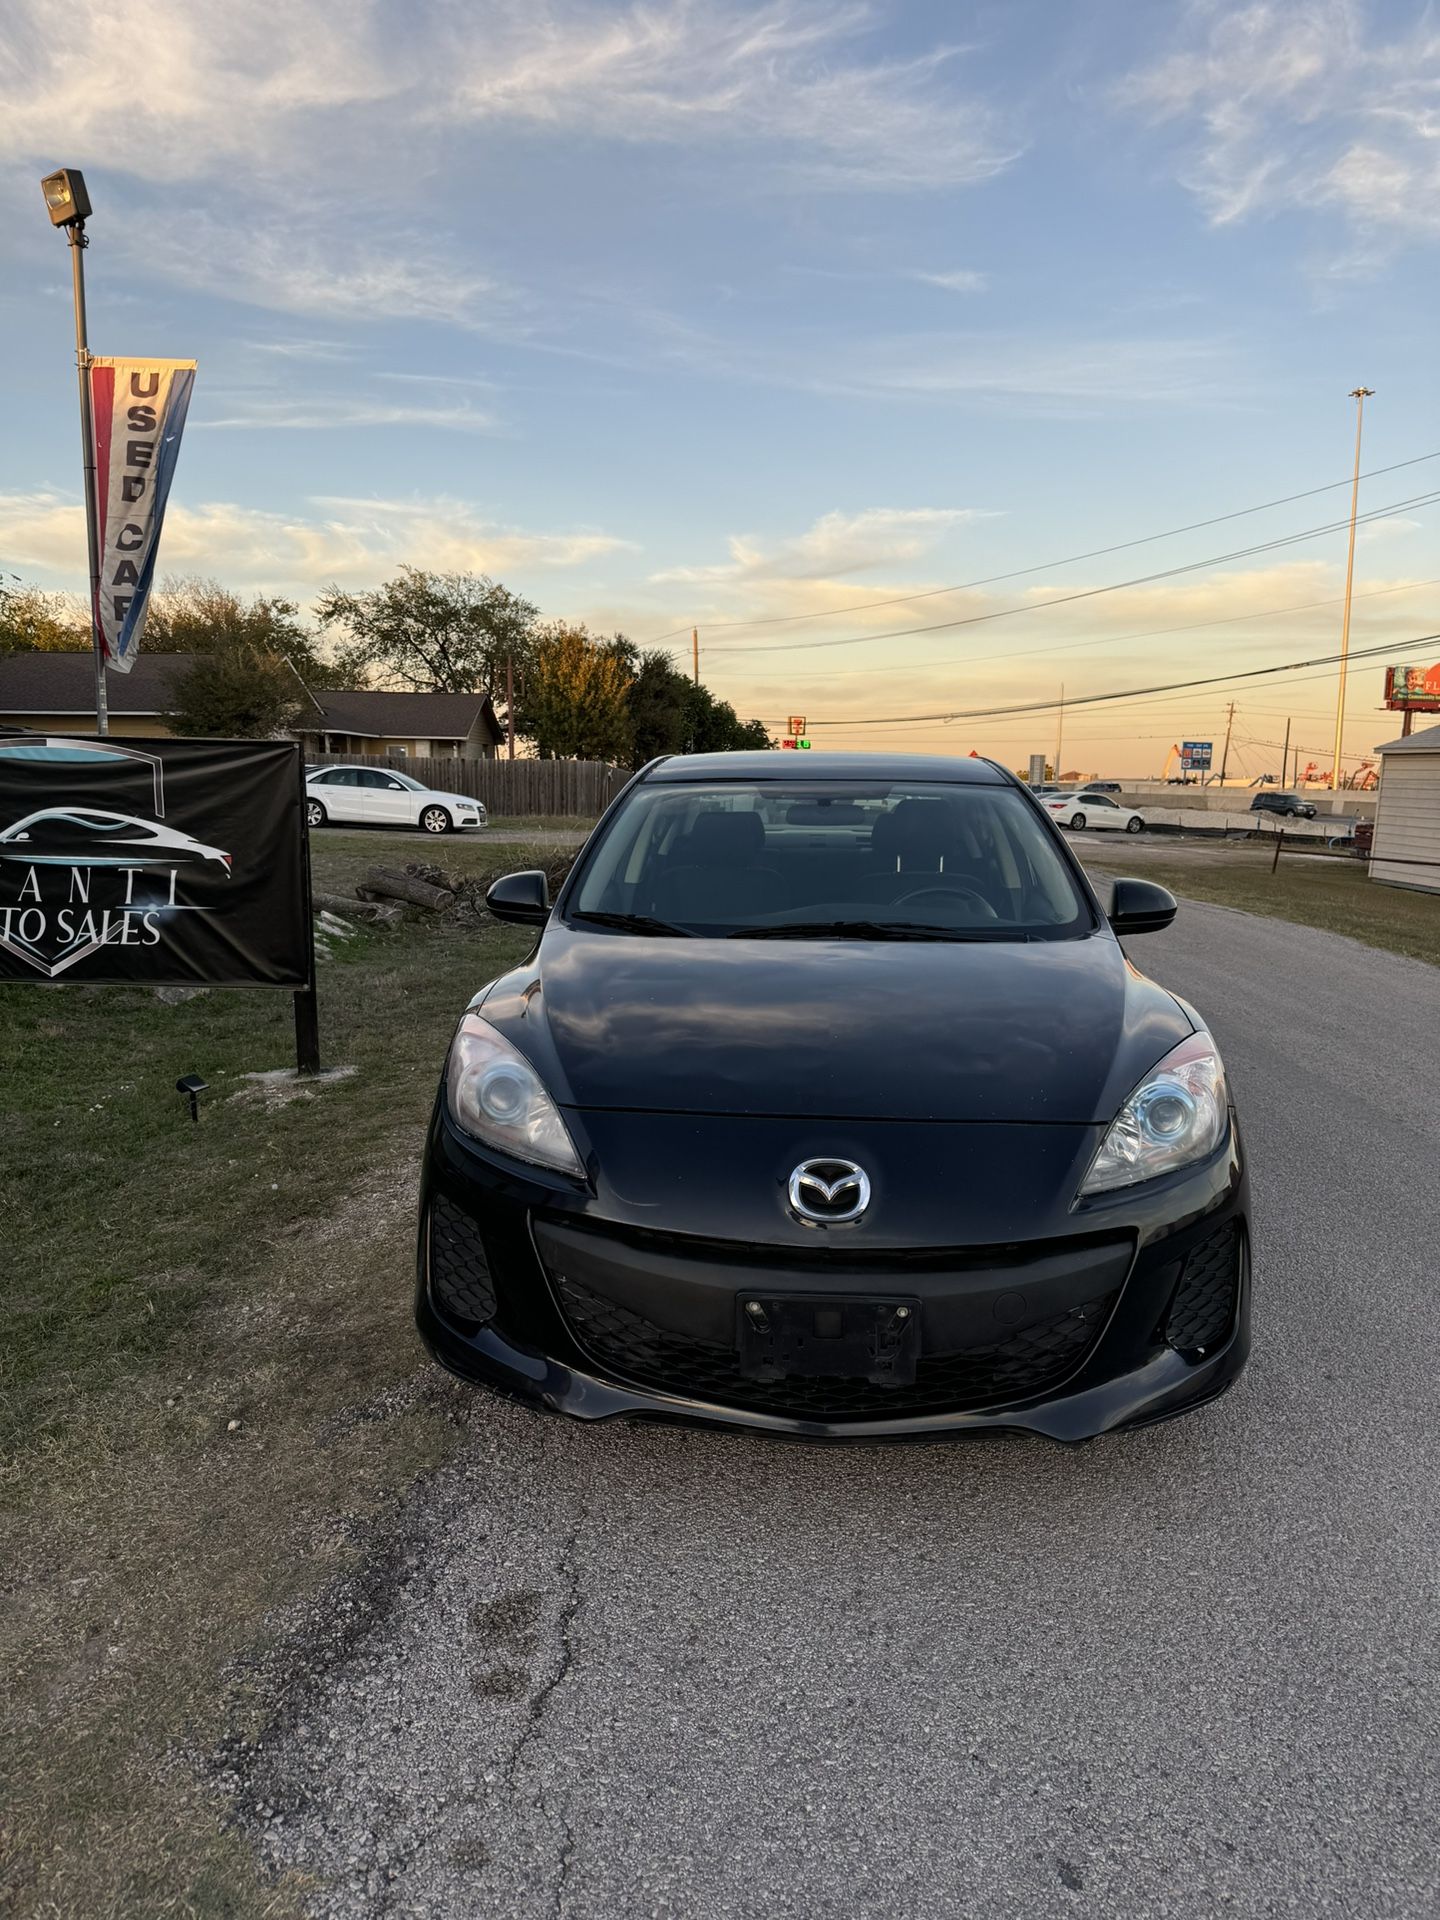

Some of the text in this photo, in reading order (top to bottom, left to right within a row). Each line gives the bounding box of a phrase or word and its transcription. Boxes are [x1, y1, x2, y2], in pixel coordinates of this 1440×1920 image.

[121, 372, 159, 503] USED
[0, 865, 178, 906] ANTI
[56, 908, 161, 946] SALES
